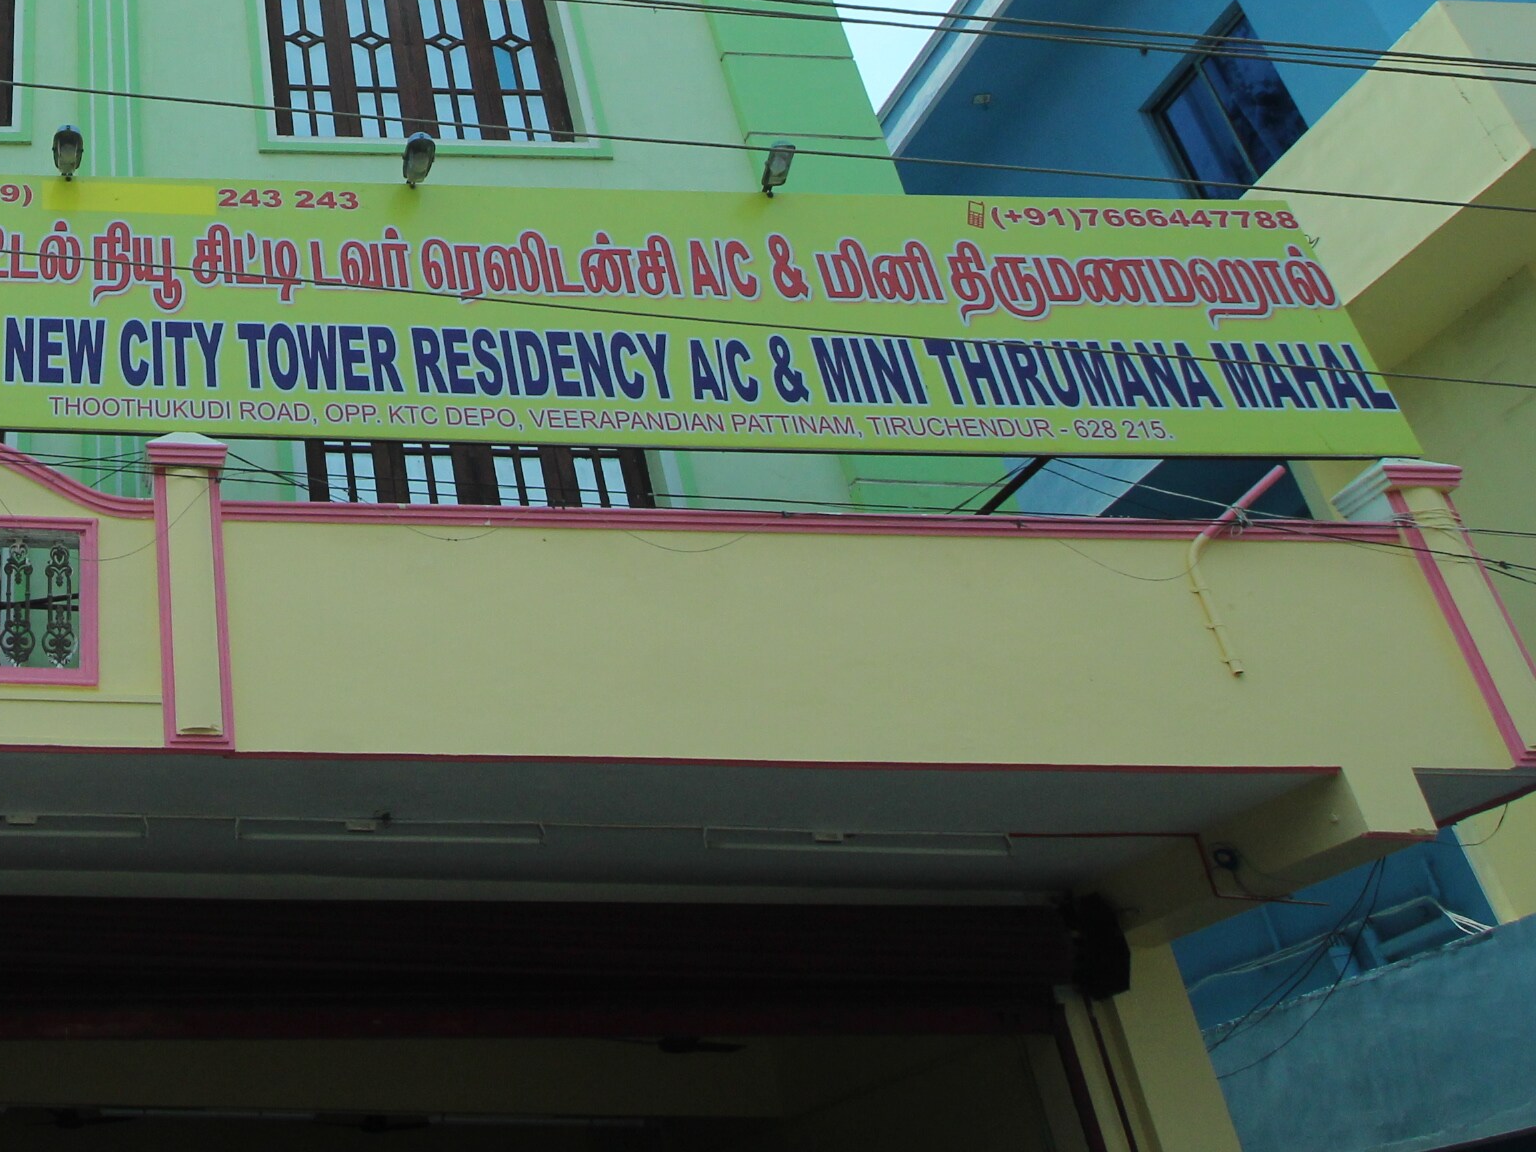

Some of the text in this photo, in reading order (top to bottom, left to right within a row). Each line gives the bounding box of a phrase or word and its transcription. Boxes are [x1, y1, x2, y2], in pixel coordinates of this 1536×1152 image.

[218, 189, 282, 209] 243
[295, 190, 359, 211] 243
[989, 206, 1300, 231] (+91)7666447788
[93, 222, 182, 310] நியூ
[690, 239, 757, 297] A/C
[768, 234, 809, 299] &
[816, 238, 945, 300] மினி
[947, 241, 1337, 326] திருமணமஹால்
[5, 316, 105, 385] NEW
[120, 319, 223, 388] CITY
[238, 323, 403, 392] TOWER
[411, 327, 669, 400] RESIDENCY
[691, 339, 758, 403] A/C
[771, 334, 810, 404] &
[811, 337, 928, 405] MINI
[927, 338, 1223, 408] THIRUMANA
[1214, 342, 1398, 410] MAHAL
[50, 396, 232, 421] THOOTHUKUDI
[240, 401, 318, 426] ROAD,
[325, 404, 381, 425] OPP.
[388, 405, 438, 426] KTC
[446, 406, 524, 430] DEPO,
[529, 408, 725, 433] VEERAPANDIAN
[731, 413, 864, 438] PATTINAM,
[866, 416, 1055, 438] TIRUCHENDUR
[1073, 419, 1117, 439] 628
[1122, 420, 1174, 439] 215.
